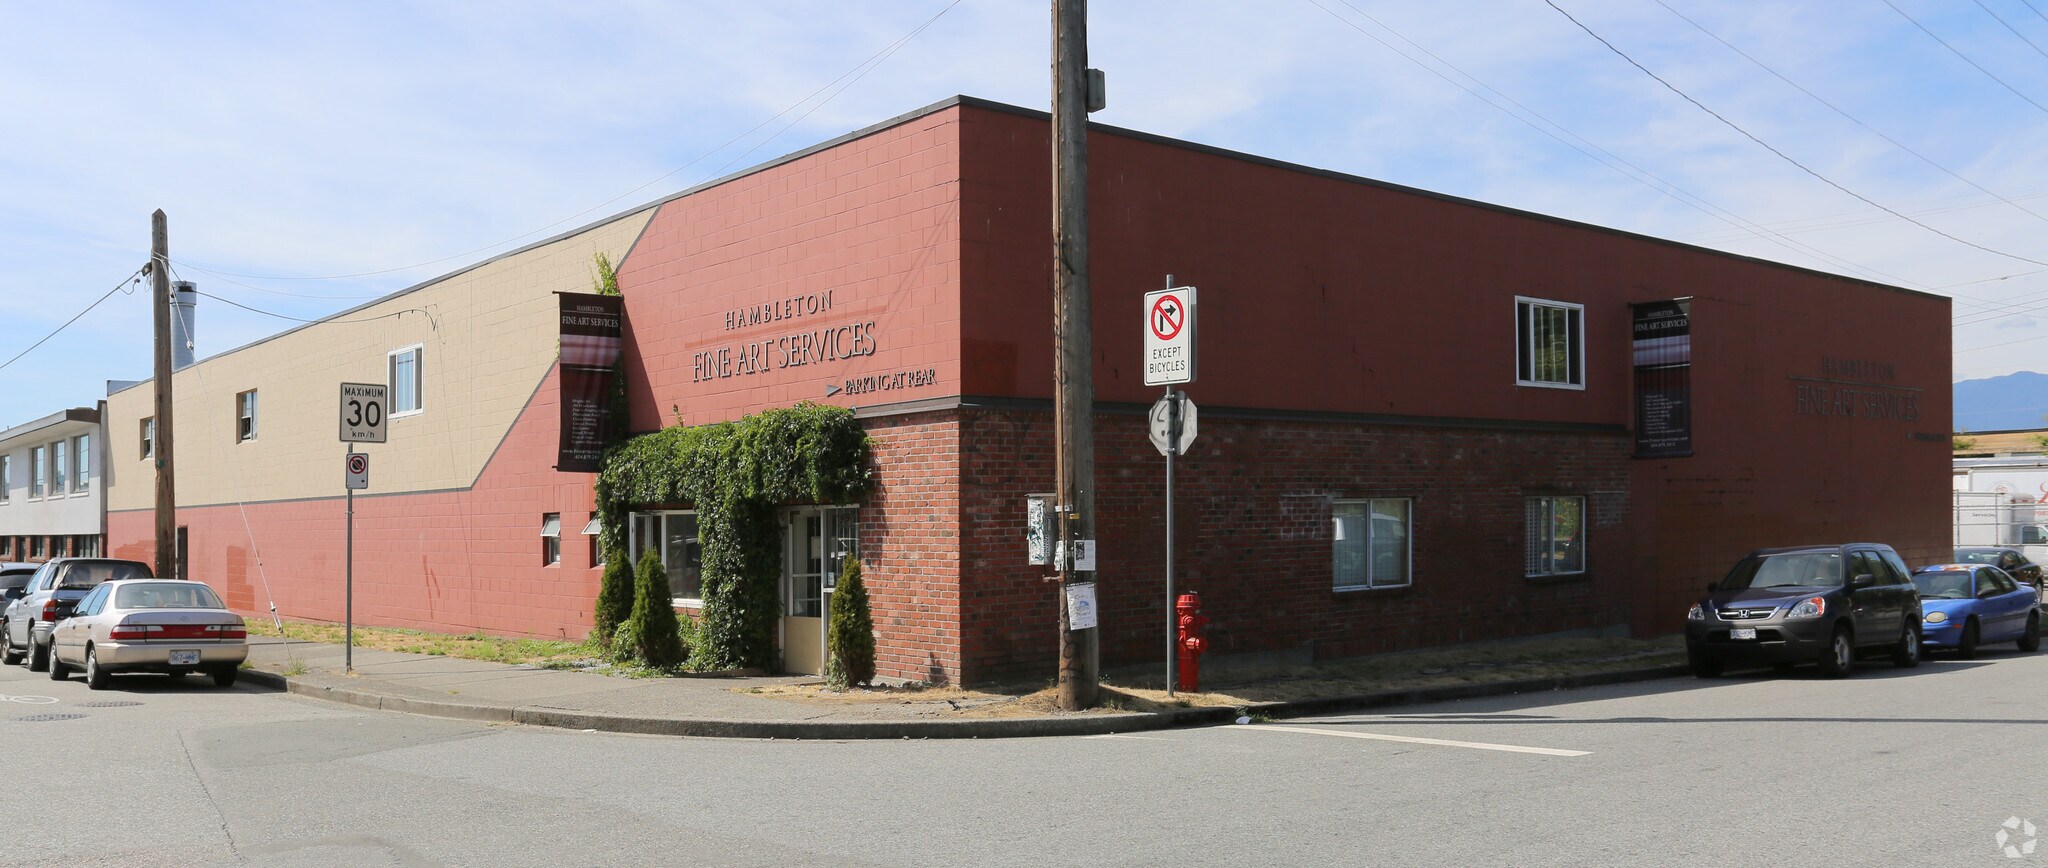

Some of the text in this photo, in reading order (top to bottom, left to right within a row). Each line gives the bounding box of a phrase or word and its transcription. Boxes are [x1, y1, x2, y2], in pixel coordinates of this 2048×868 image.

[725, 289, 832, 330] HAMBLETON
[562, 316, 618, 327] FINE ART SERVICES
[1635, 319, 1687, 332] FINE ART SERVICES
[693, 321, 876, 383] FINE ART SERVICES
[1153, 346, 1181, 359] EXCEPT
[1150, 360, 1185, 373] BICYCLES
[845, 368, 937, 395] PARKING AT REAR
[345, 387, 384, 397] MAXIMUM
[1796, 384, 1921, 421] FINE ART SERVICES
[347, 400, 380, 427] 30
